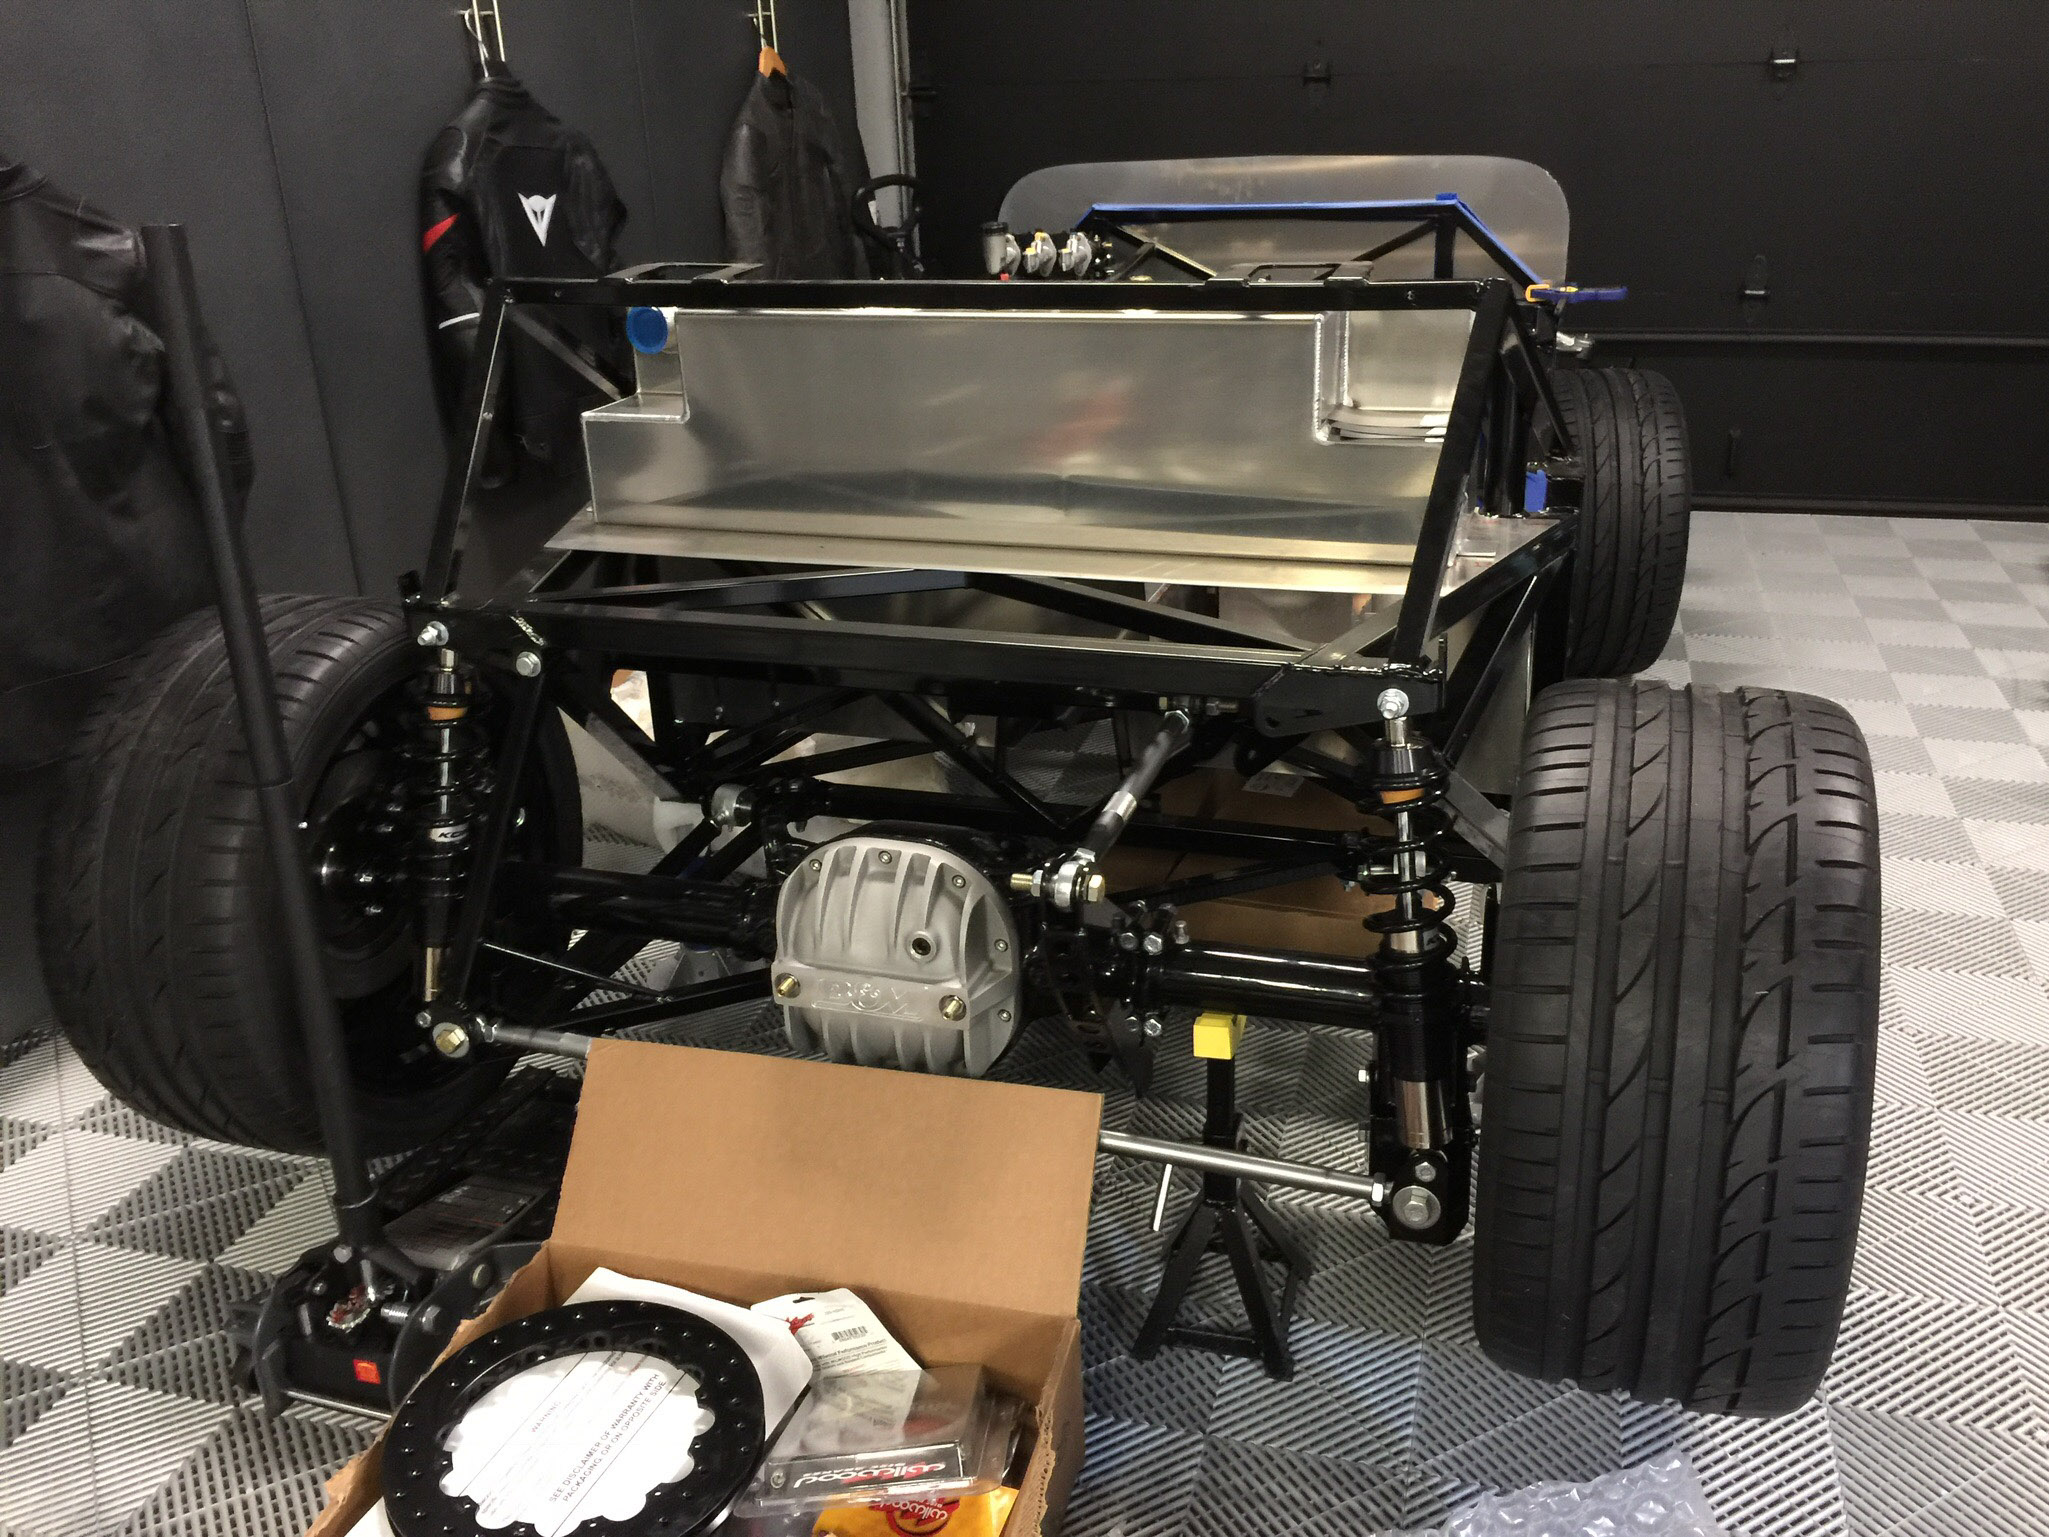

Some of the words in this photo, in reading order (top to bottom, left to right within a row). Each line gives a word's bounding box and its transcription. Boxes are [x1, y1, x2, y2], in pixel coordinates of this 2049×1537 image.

[549, 1486, 566, 1503] SEE
[563, 1441, 602, 1486] DISCLAIMER
[600, 1429, 611, 1441] OF
[610, 1390, 645, 1430] WARRANTY
[642, 1373, 660, 1392] WITH
[563, 1456, 603, 1503] PACKAGING
[600, 1444, 612, 1456] OR
[611, 1431, 623, 1444] ON
[621, 1396, 652, 1432] OPPOSITE
[793, 1462, 946, 1489] wilwood
